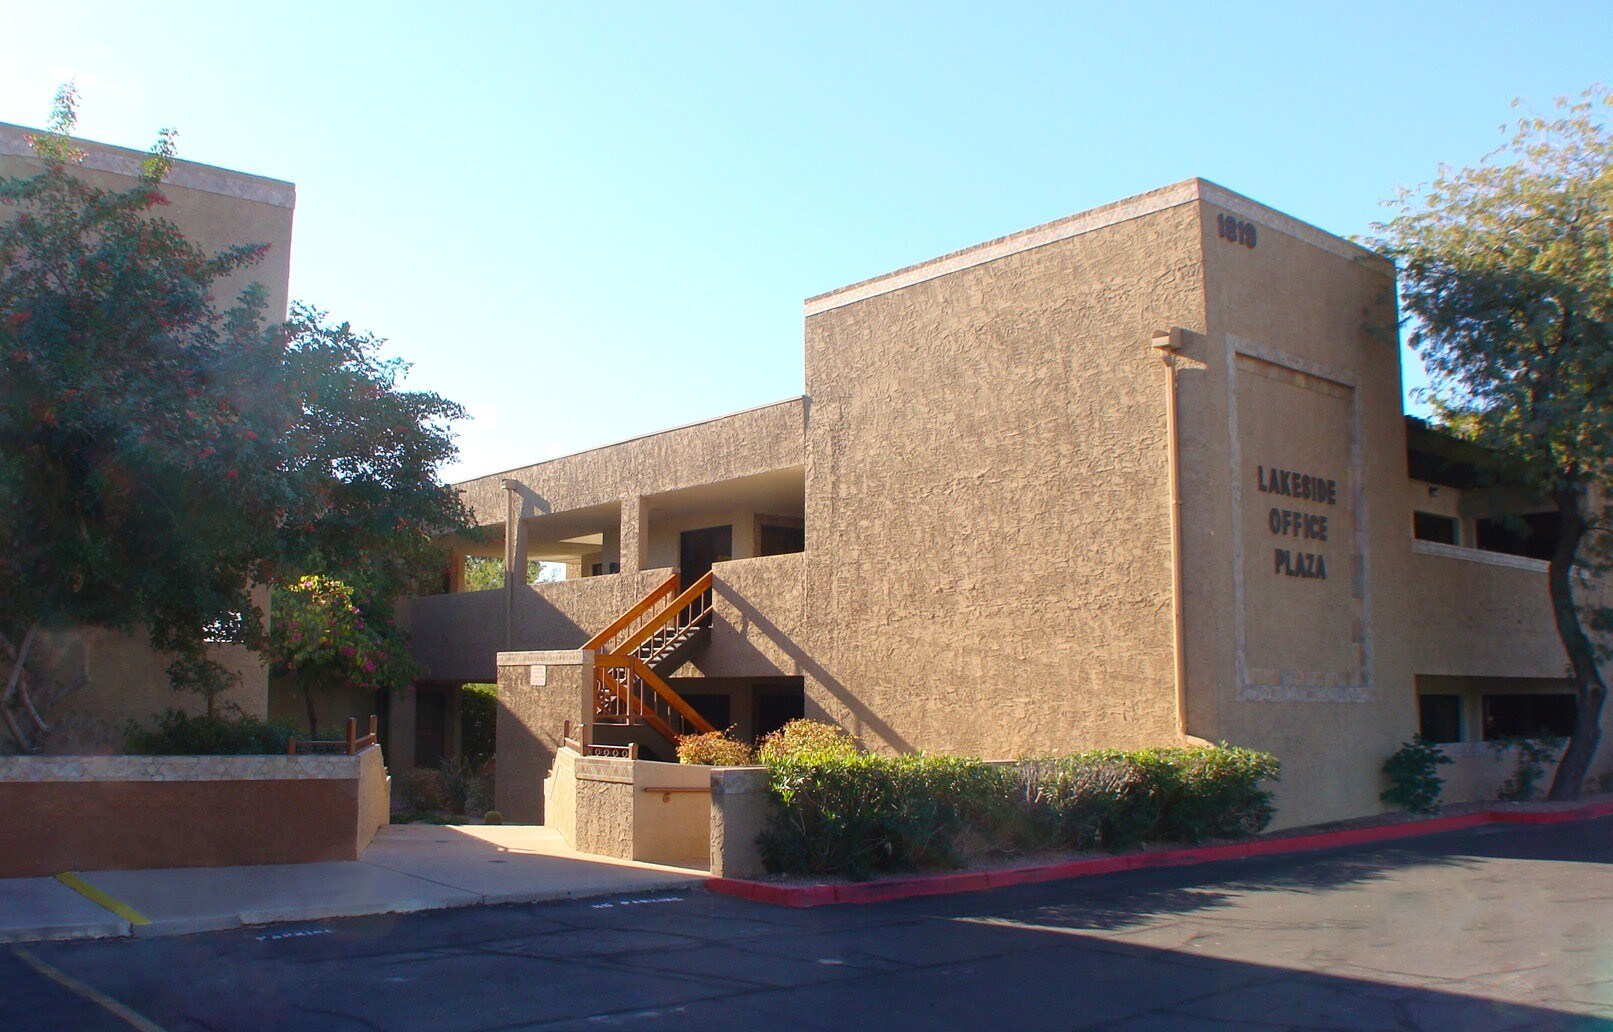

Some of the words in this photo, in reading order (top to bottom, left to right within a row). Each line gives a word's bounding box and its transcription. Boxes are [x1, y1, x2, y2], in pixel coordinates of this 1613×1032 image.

[1258, 465, 1336, 505] LAKESIDE
[1268, 508, 1328, 541] OFFICE
[1274, 549, 1326, 580] PLAZA
